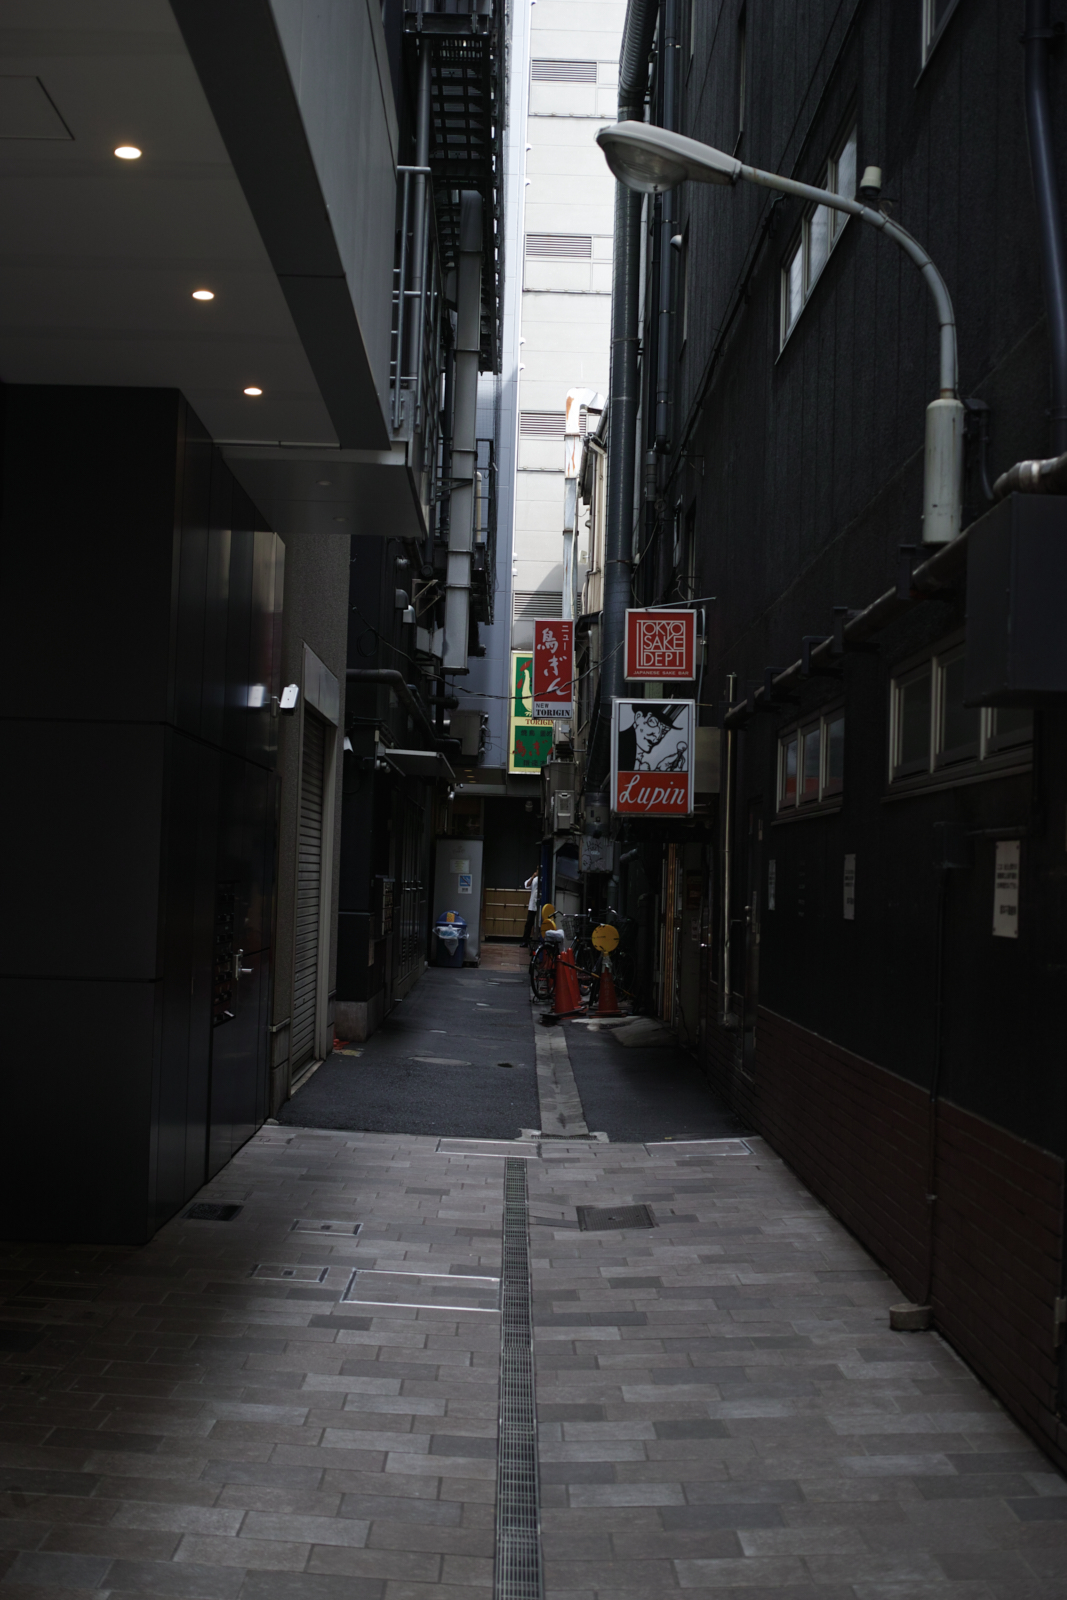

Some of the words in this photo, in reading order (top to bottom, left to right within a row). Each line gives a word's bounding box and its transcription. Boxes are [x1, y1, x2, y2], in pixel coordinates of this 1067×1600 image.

[561, 625, 569, 651] ニュー
[636, 620, 684, 638] TOKYO
[643, 635, 684, 651] SAKE
[536, 627, 570, 696] 鳥ぎん
[643, 651, 684, 666] DEPT
[535, 709, 571, 717] TORIGIN
[619, 774, 686, 811] Lupin
